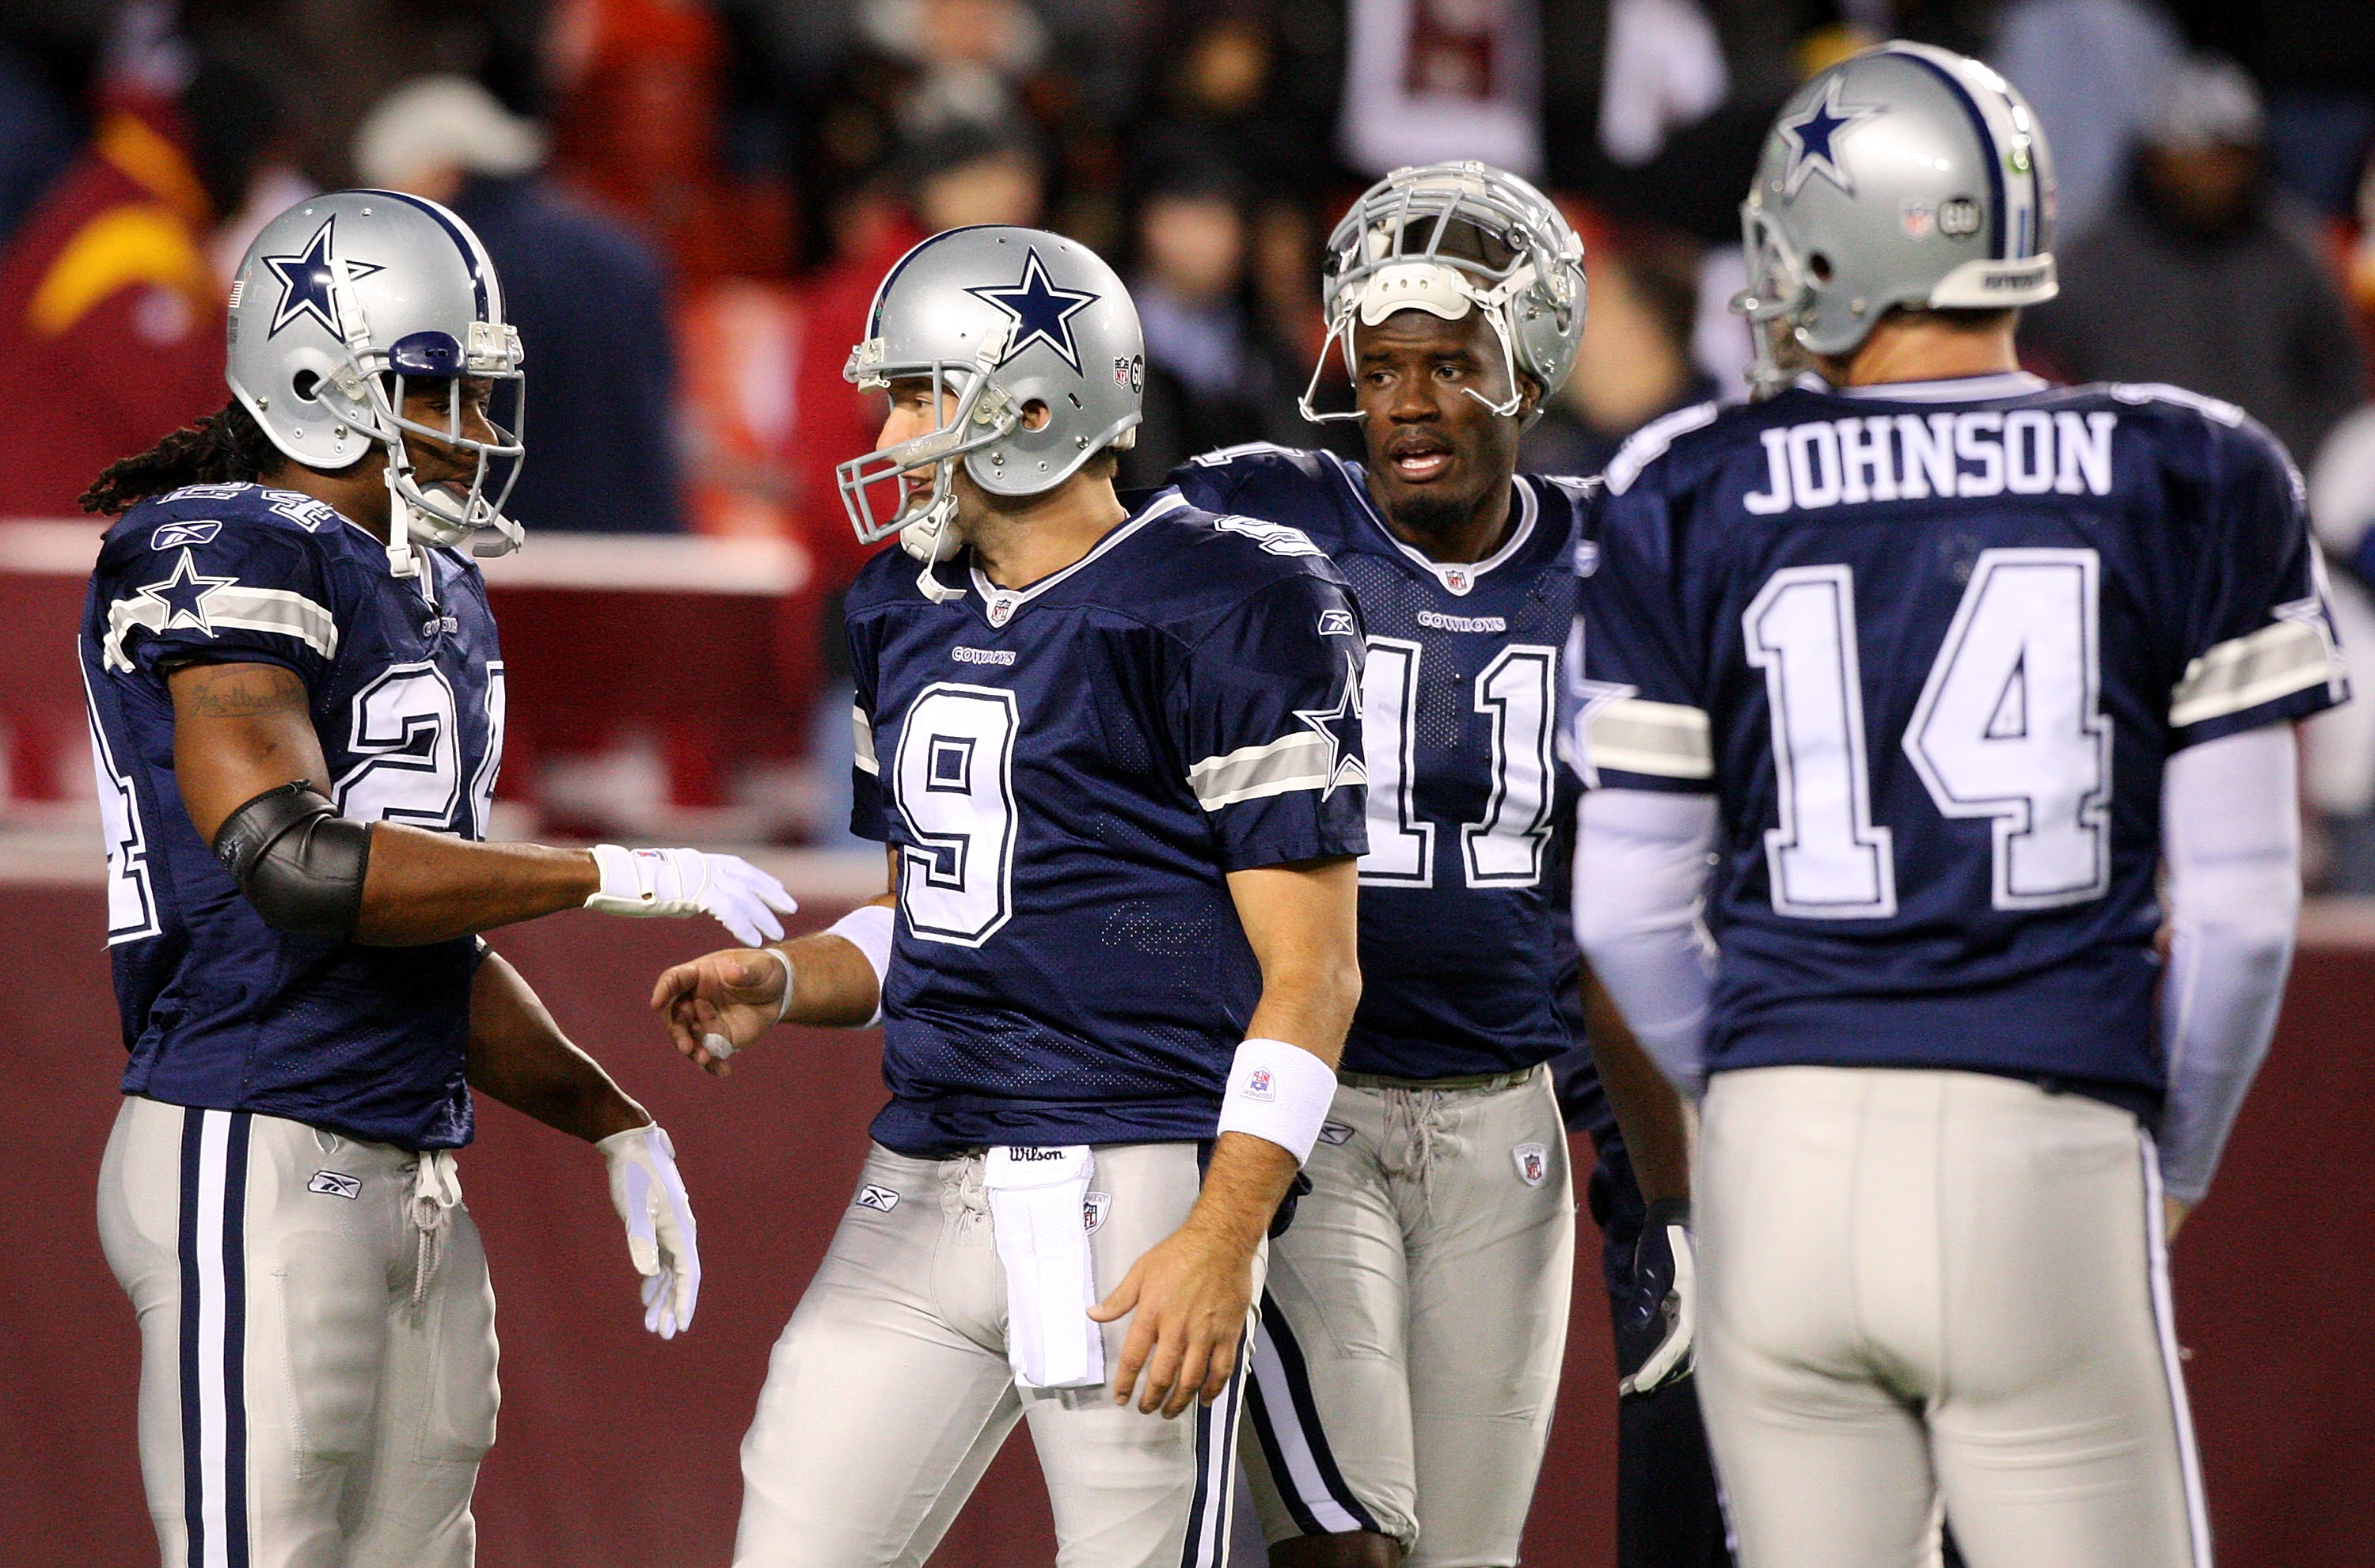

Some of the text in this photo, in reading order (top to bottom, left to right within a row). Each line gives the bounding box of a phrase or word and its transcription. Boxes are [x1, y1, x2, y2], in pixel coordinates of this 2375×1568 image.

[1743, 410, 2117, 514] JOHNSON
[952, 646, 1016, 666] COWBOYS
[1417, 610, 1507, 632] COWBOYS
[1356, 636, 1557, 889] 11
[1742, 547, 2113, 918] 14
[893, 681, 1020, 948] 9
[1009, 1146, 1064, 1162] Wilson
